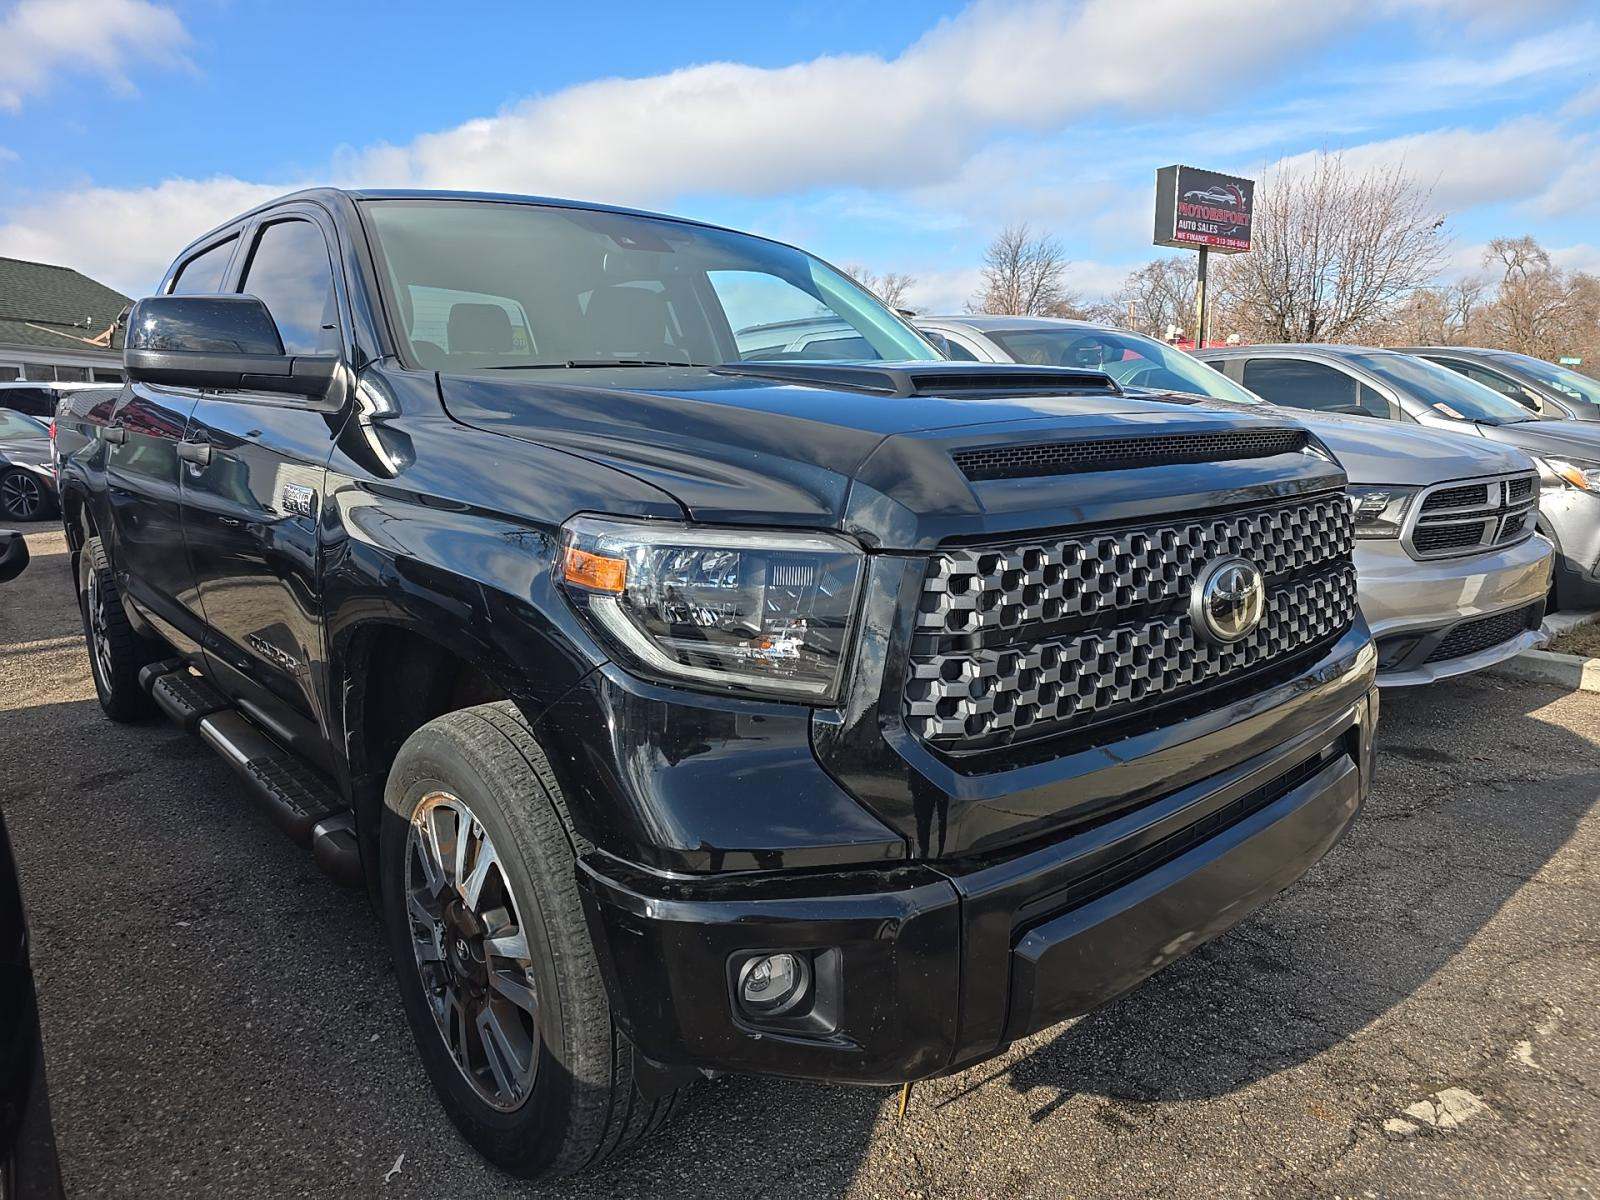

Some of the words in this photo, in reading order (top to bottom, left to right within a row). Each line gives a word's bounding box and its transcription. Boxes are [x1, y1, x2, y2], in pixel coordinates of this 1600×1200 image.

[1179, 202, 1250, 225] MOTORSPORT
[1178, 219, 1196, 230] AUTO
[1197, 222, 1218, 234] SALES
[1177, 231, 1186, 240] WE
[1187, 233, 1208, 242] FINANCE
